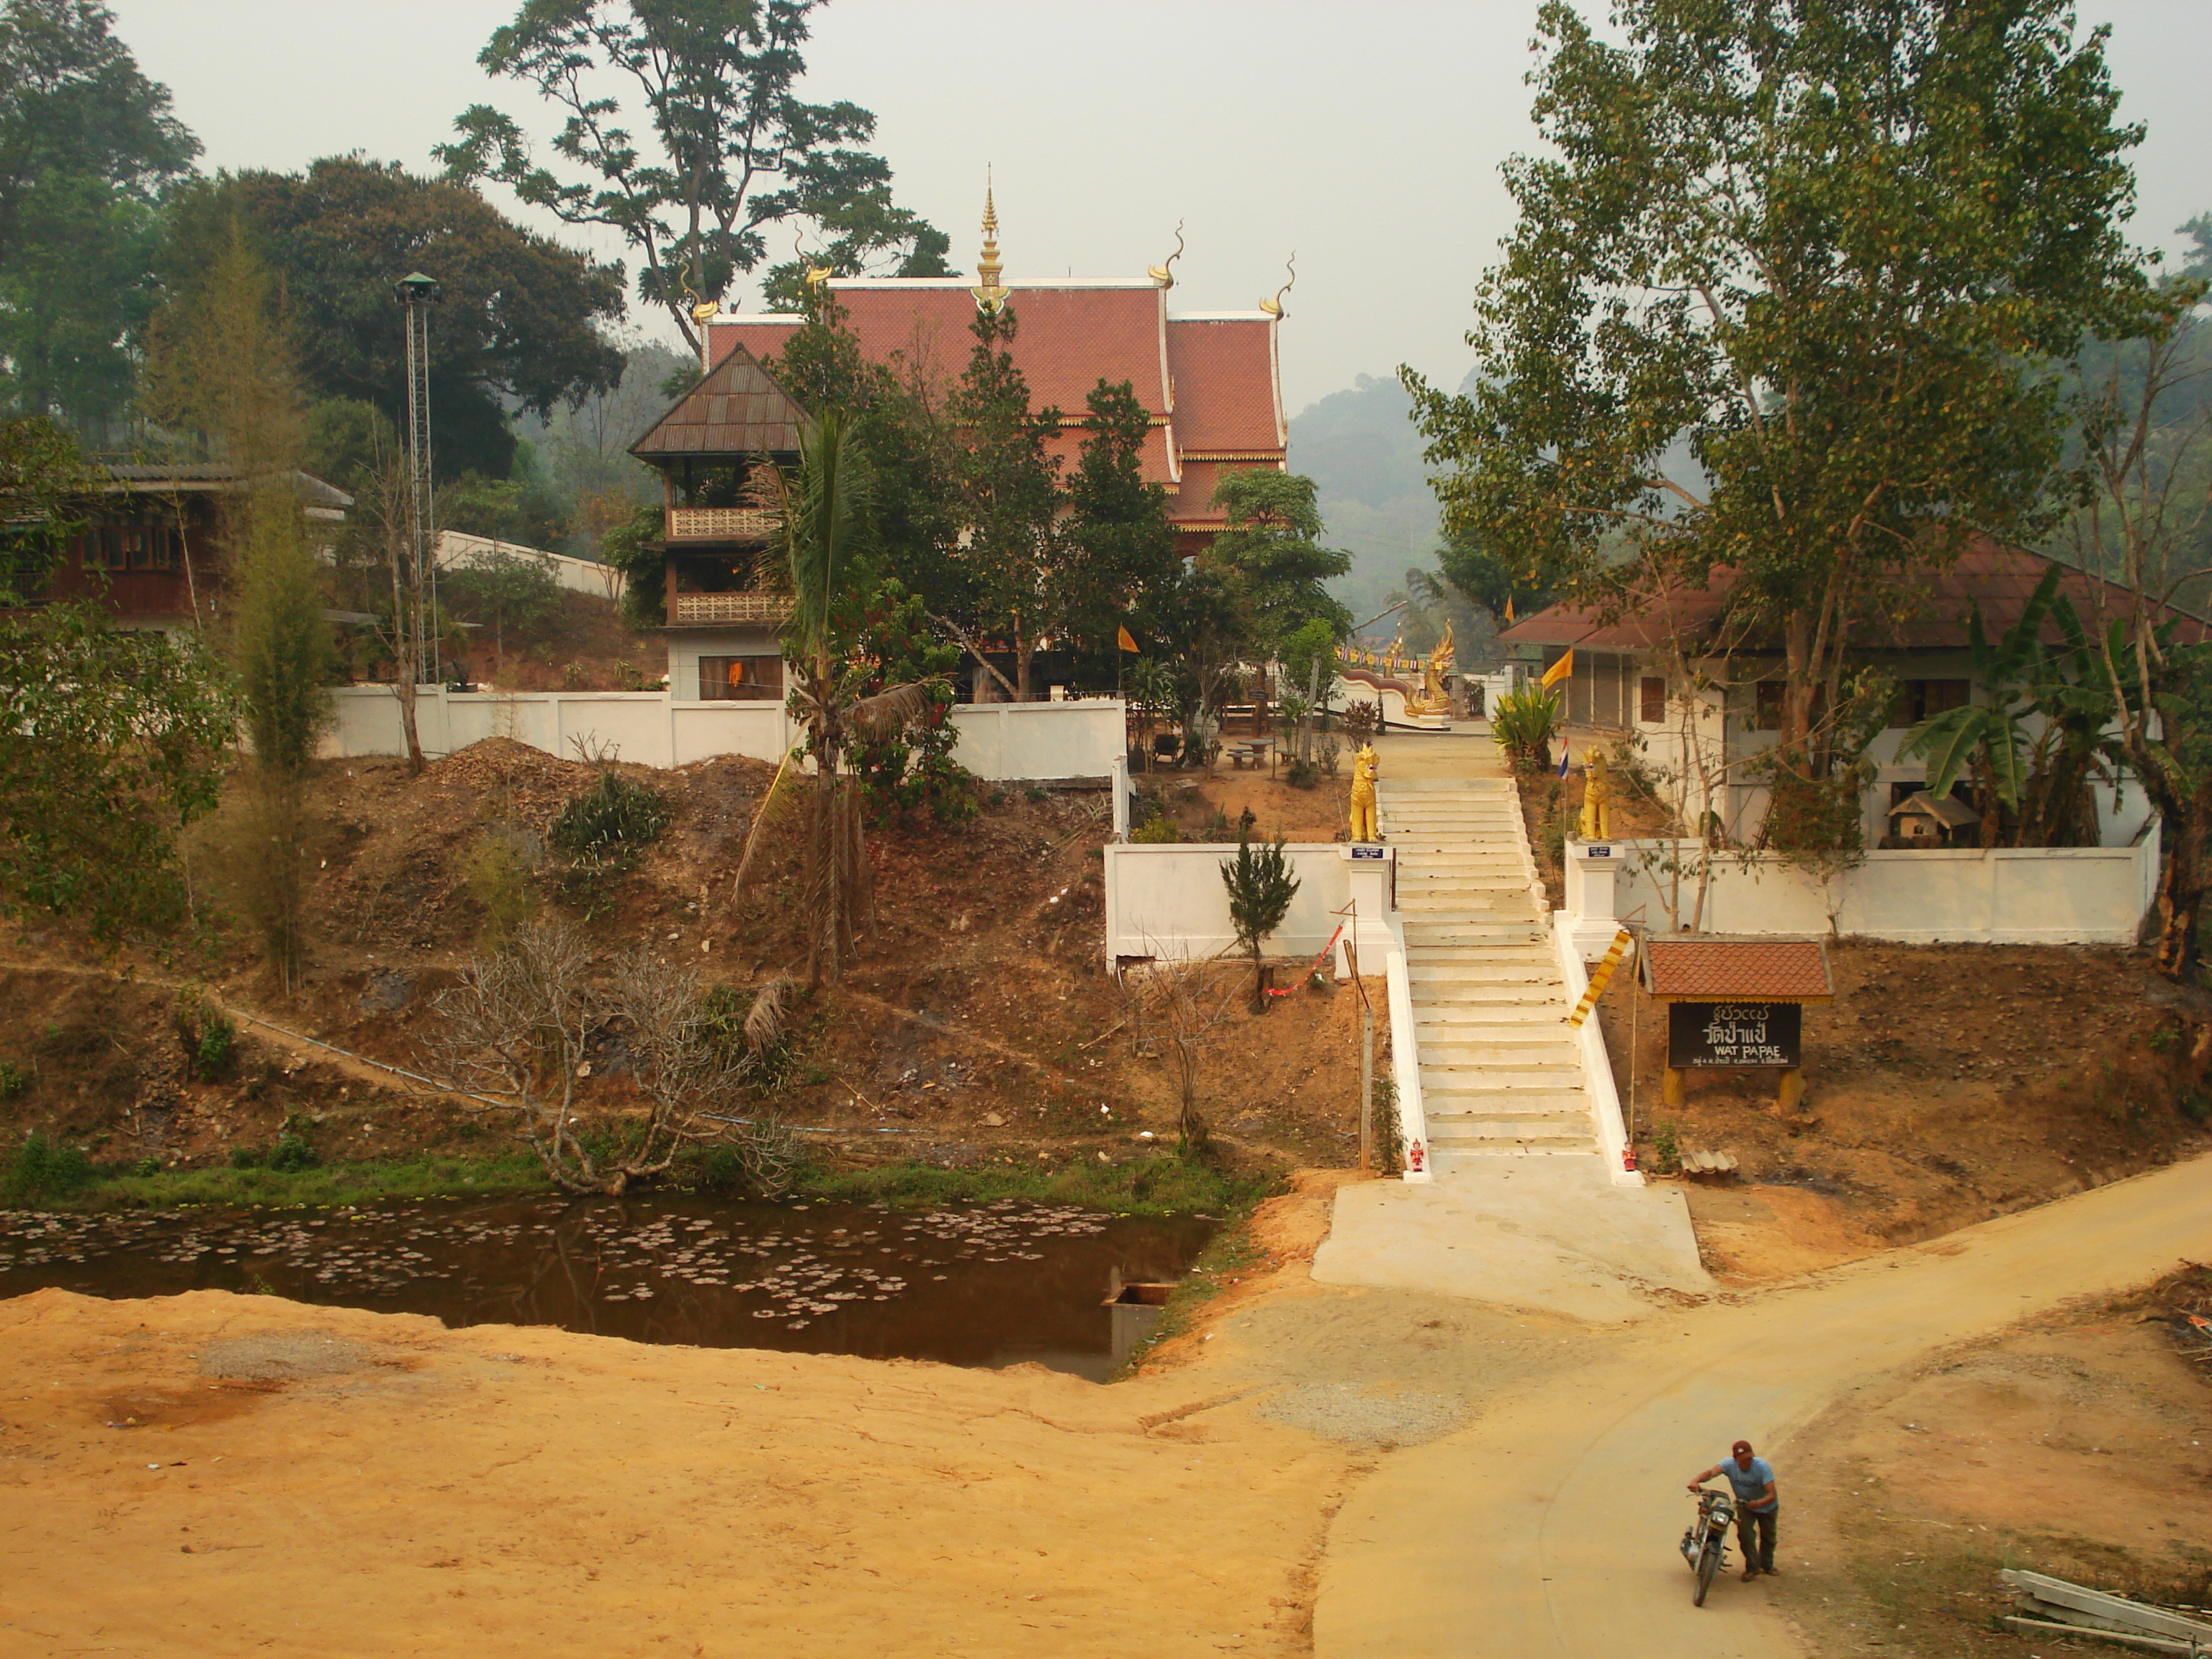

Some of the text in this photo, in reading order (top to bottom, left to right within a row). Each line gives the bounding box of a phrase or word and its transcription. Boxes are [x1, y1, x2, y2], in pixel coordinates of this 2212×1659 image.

[1702, 1020, 1766, 1044] วัดป่าแป๋
[1714, 1046, 1739, 1056] WAT
